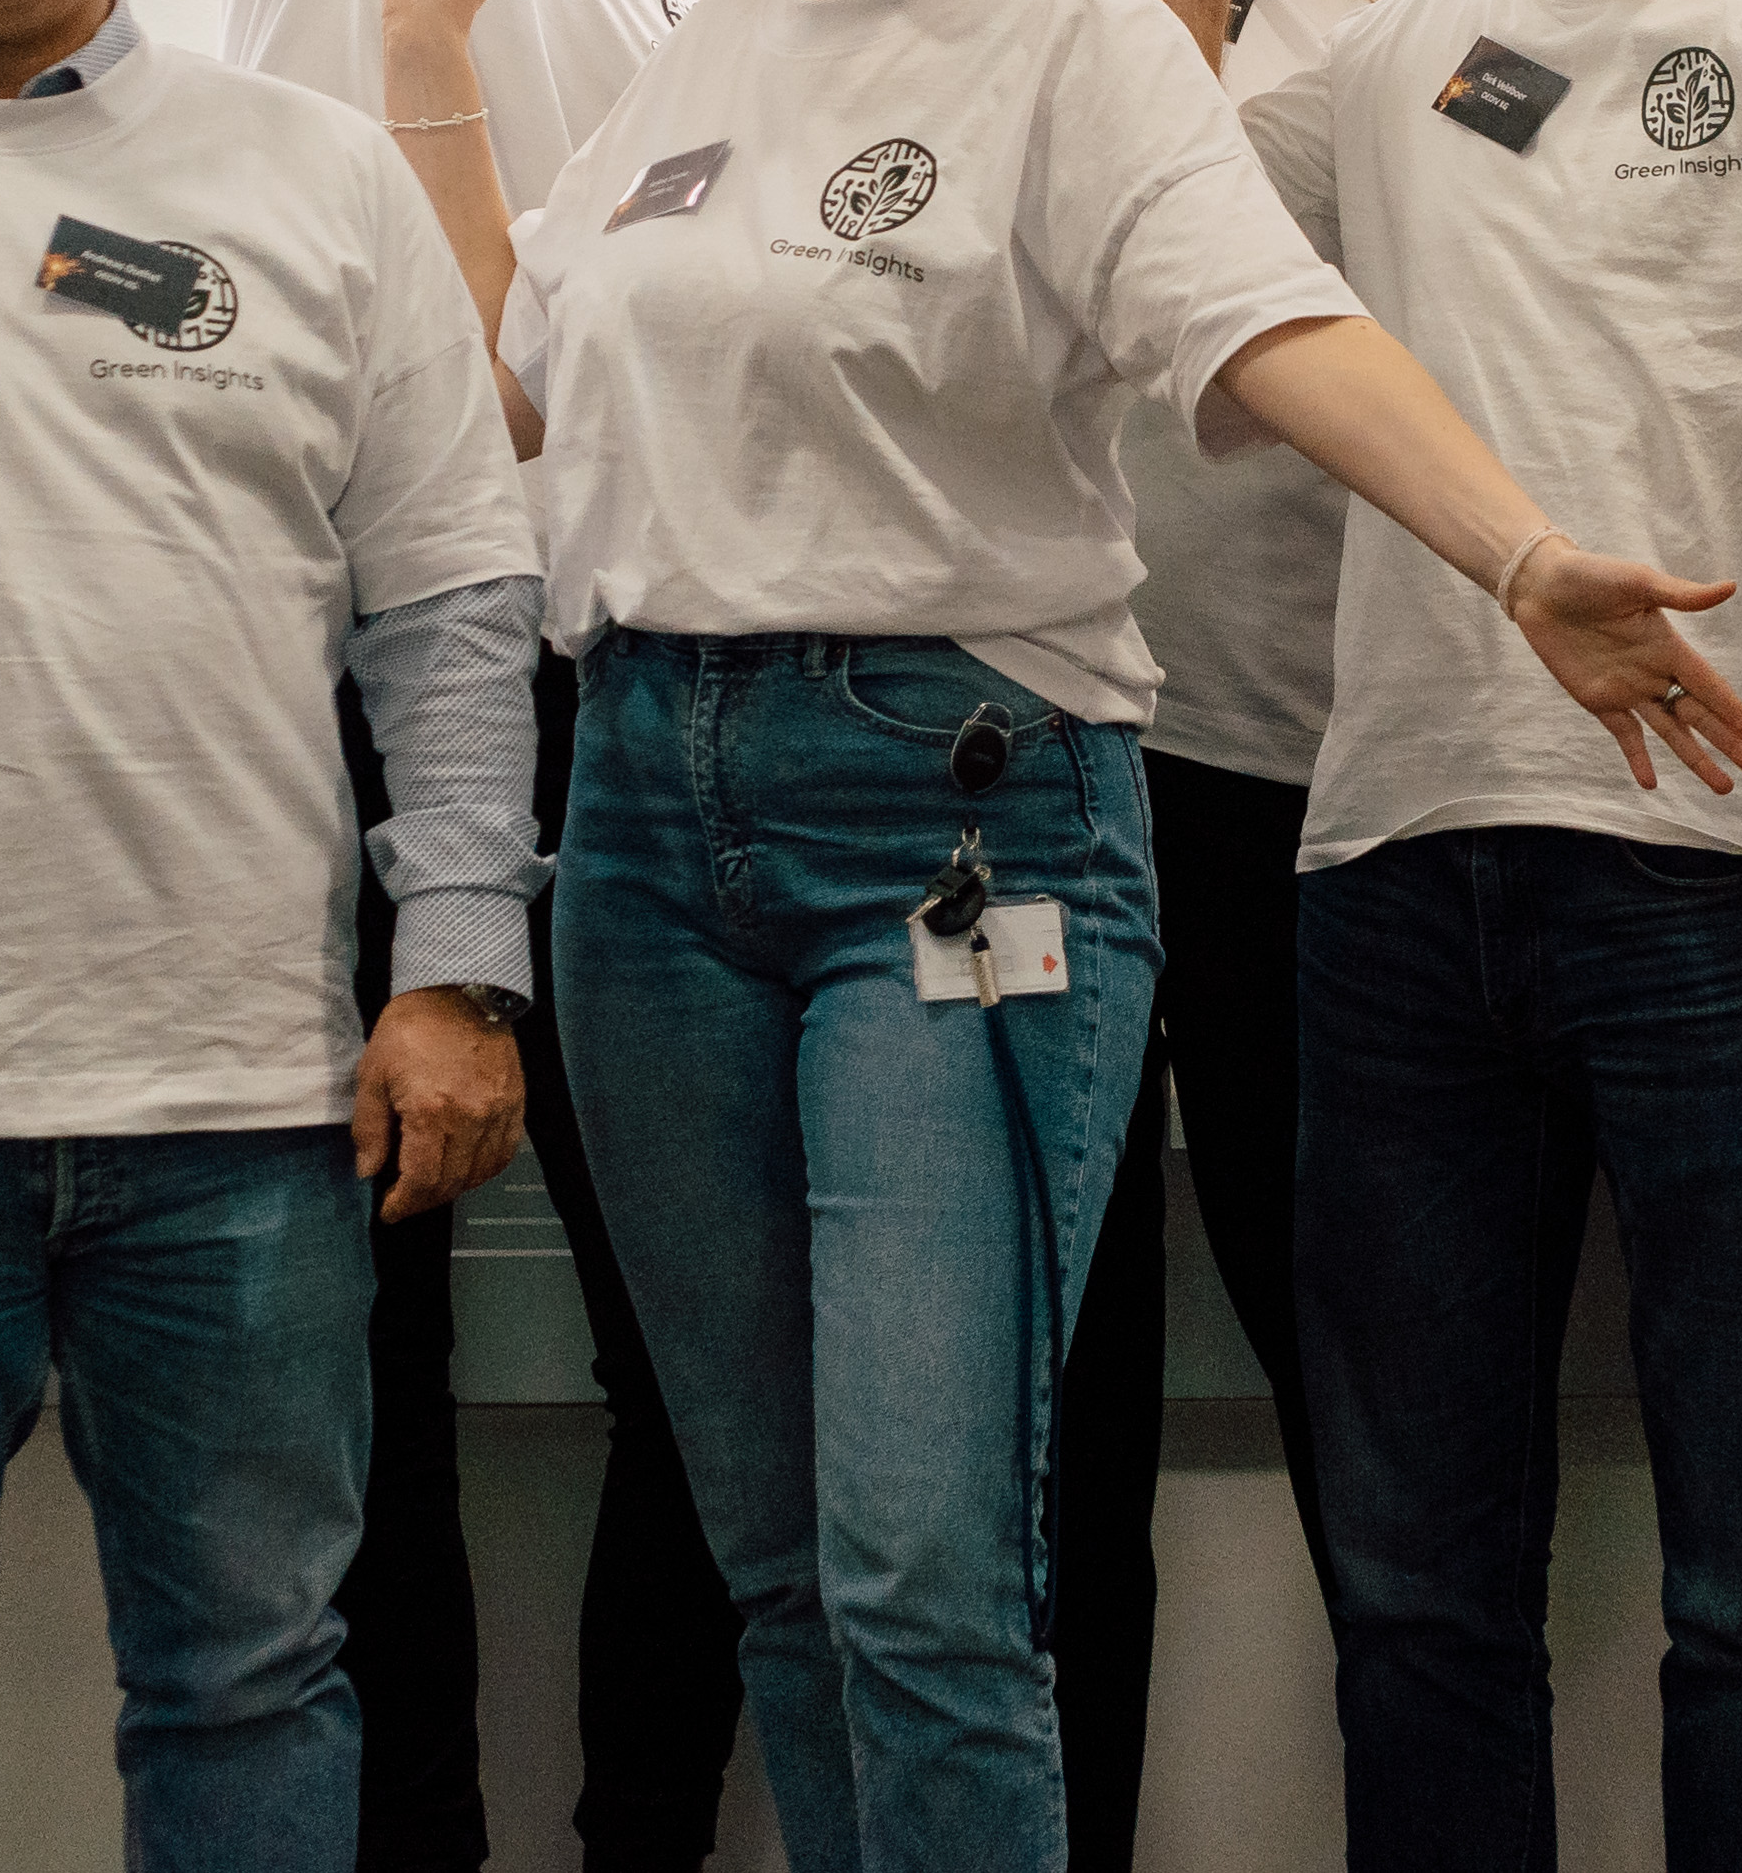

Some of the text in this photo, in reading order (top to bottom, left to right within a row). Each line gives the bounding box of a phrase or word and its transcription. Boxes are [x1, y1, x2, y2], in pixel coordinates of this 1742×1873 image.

[1482, 72, 1498, 86] Dirk
[1615, 163, 1675, 179] Green
[770, 239, 924, 282] Green Insights
[90, 359, 264, 390] Green Insights
